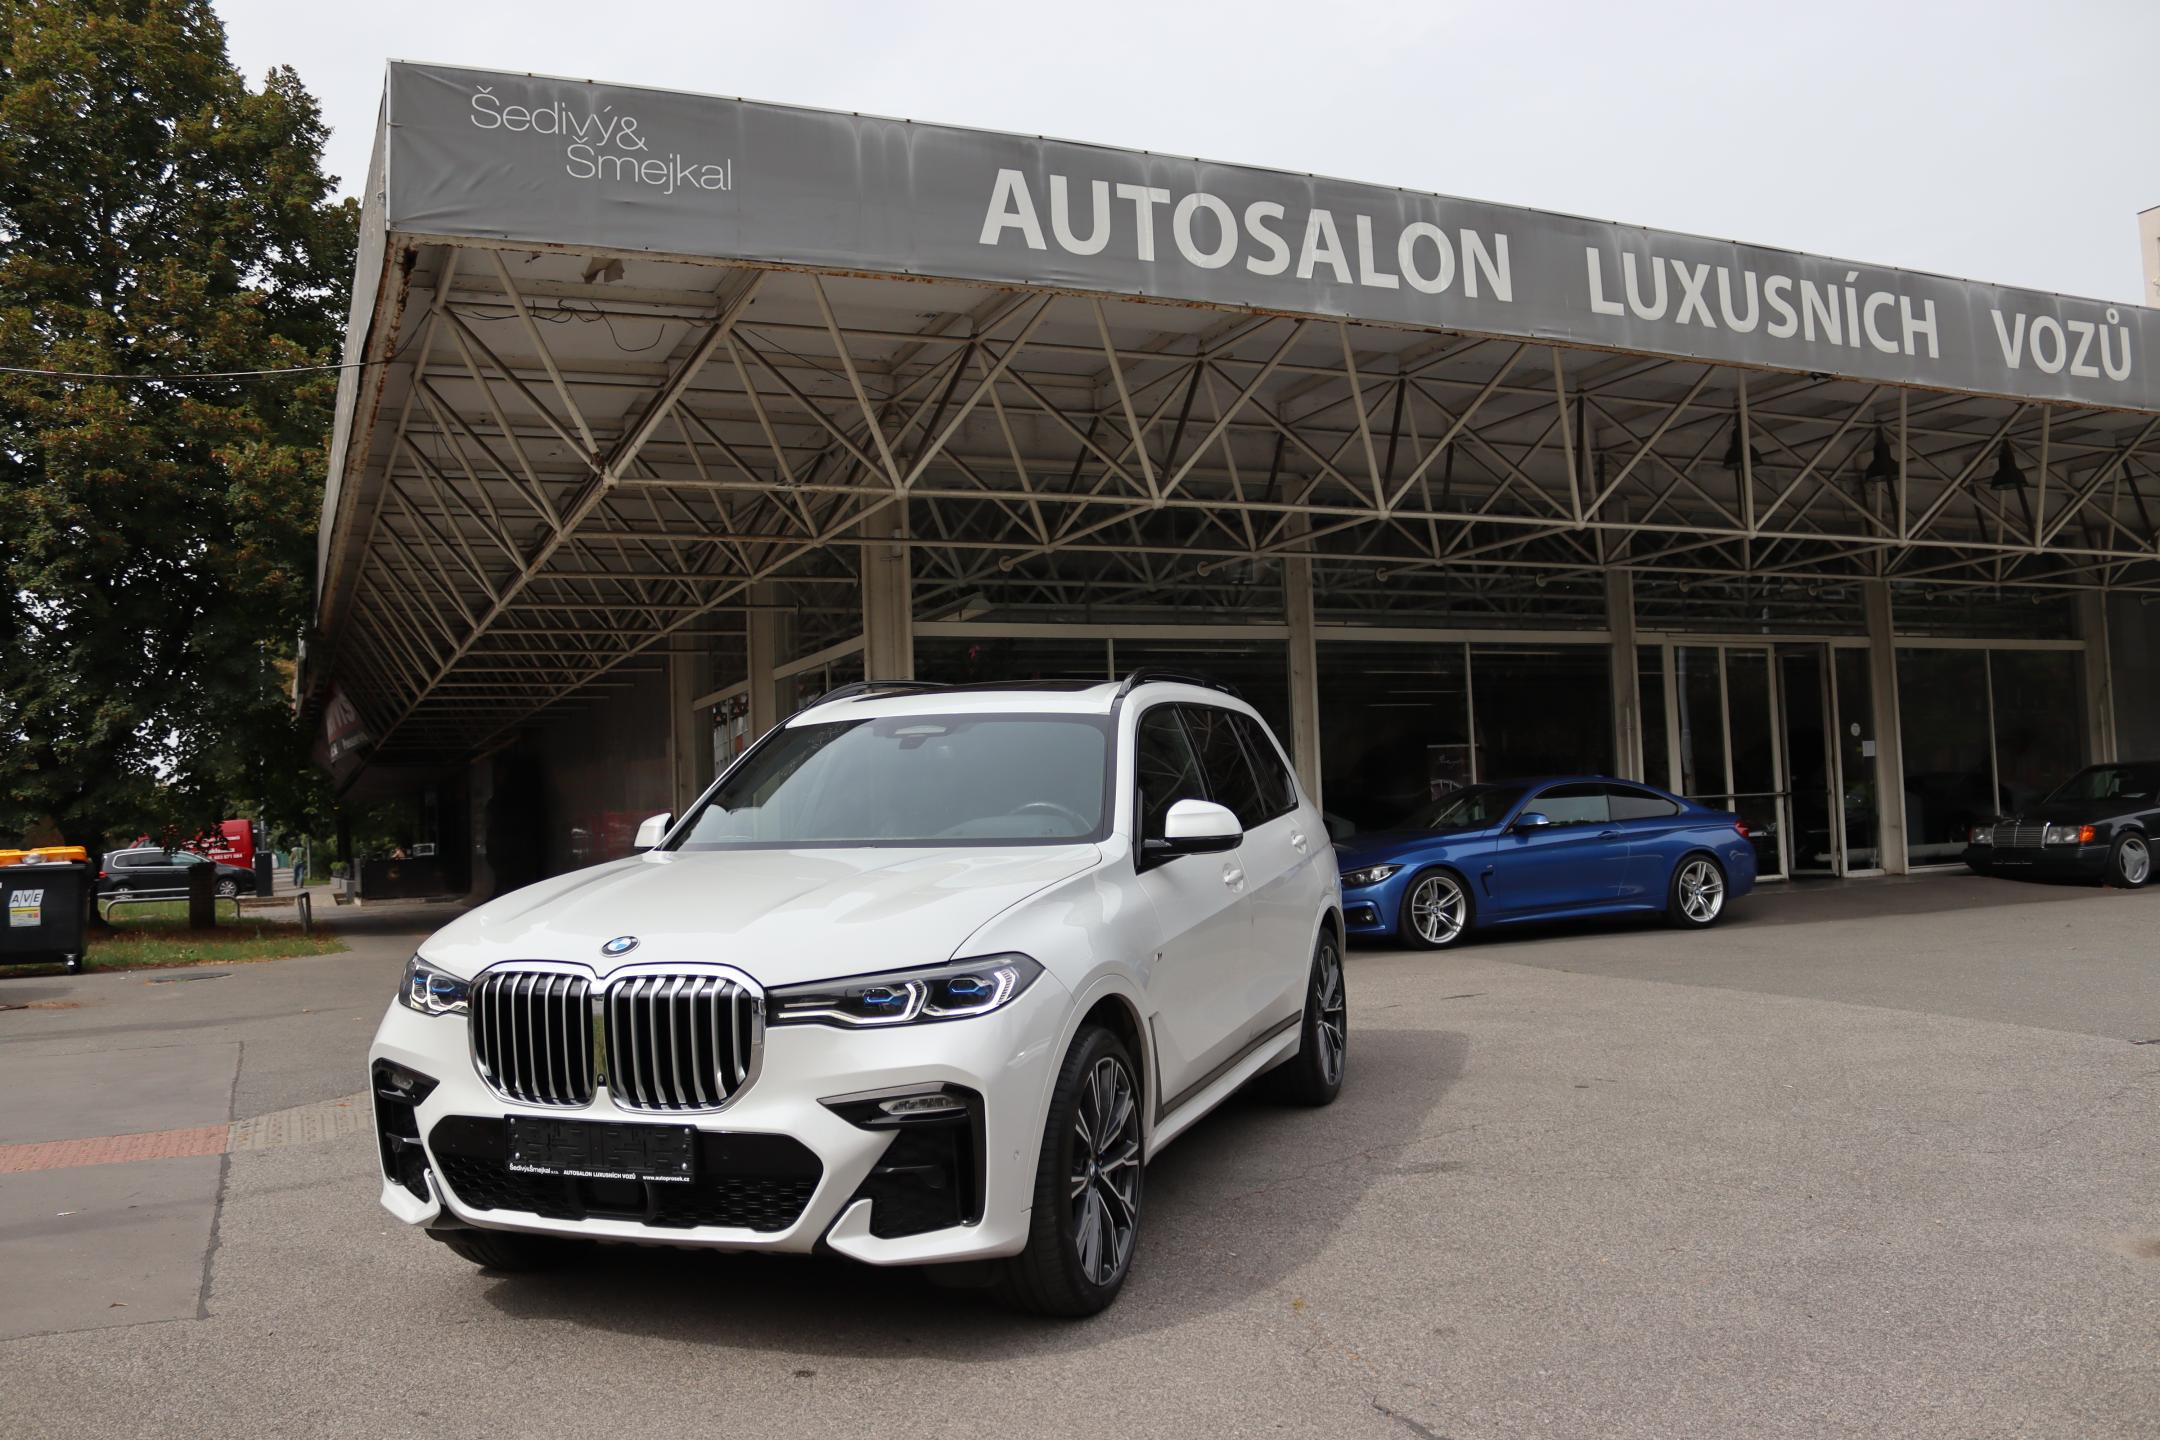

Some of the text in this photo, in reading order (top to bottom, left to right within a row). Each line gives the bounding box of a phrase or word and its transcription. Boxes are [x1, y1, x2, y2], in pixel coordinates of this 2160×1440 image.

[470, 85, 648, 151] Šedivý&
[566, 136, 732, 194] Šmejkal
[978, 168, 2132, 382] AUTOSALON LUXUSNÍCH VOZŮ
[11, 893, 41, 904] AVE
[563, 1169, 593, 1177] AUTOSALON
[593, 1171, 622, 1179] LUXUSNÍCH
[622, 1172, 637, 1180] VOZŮ
